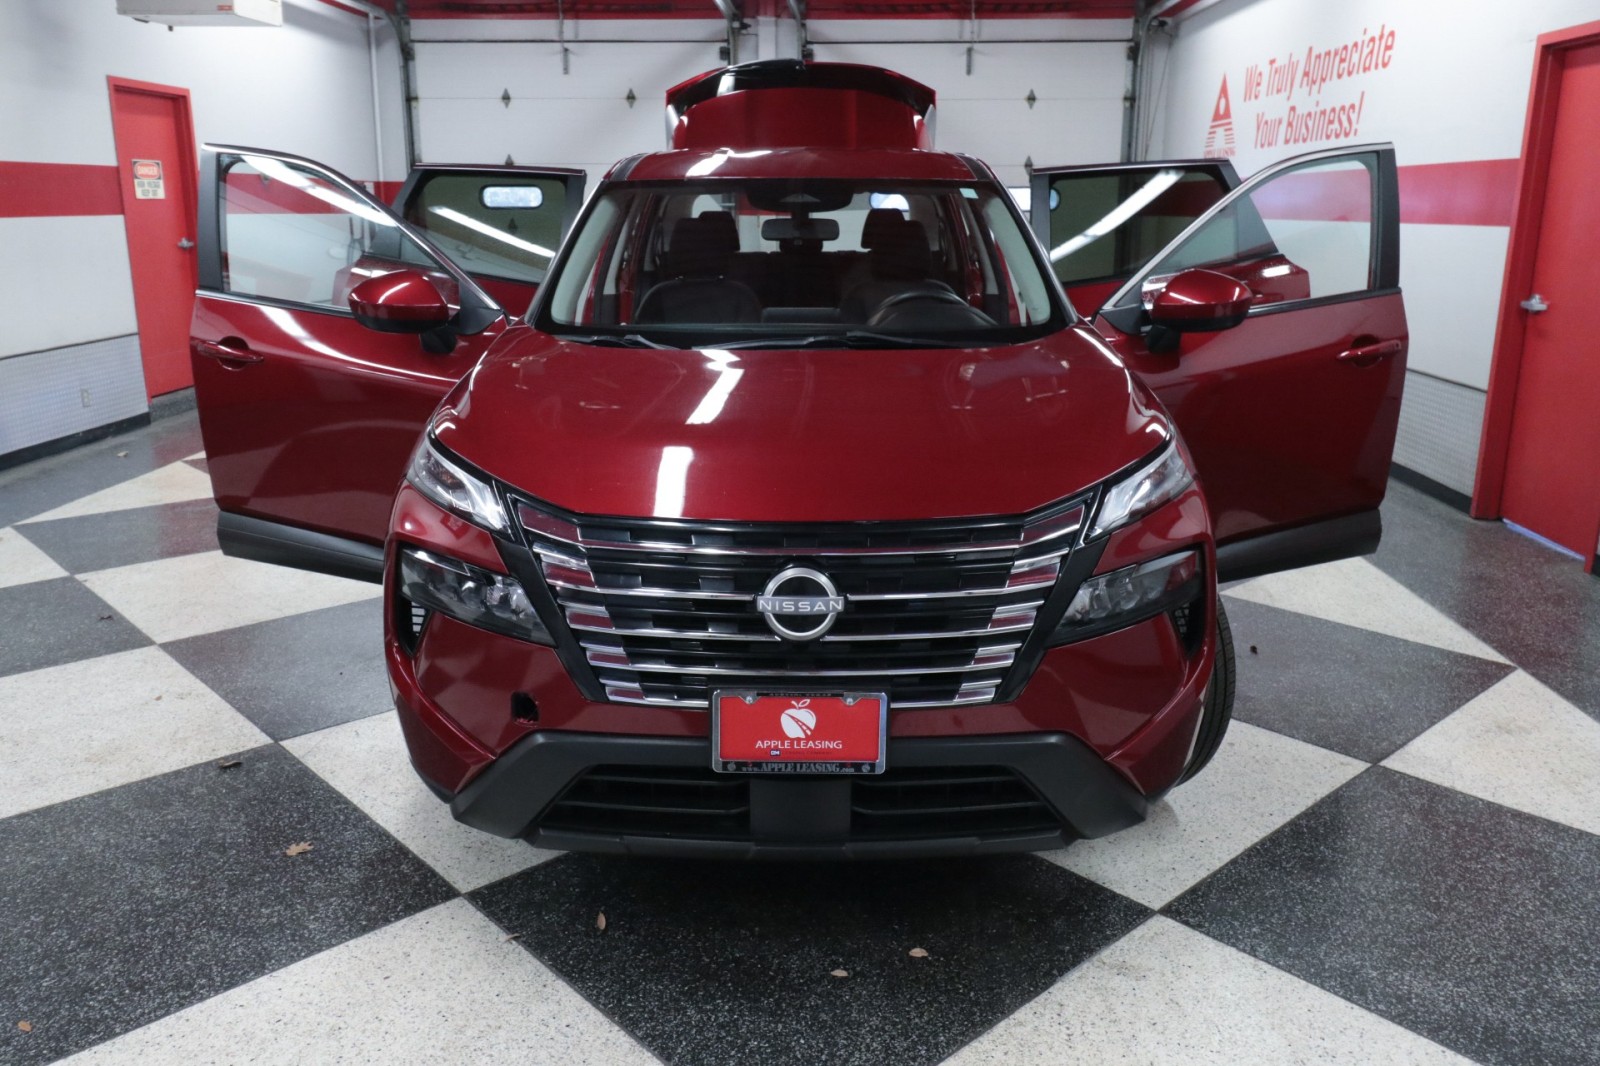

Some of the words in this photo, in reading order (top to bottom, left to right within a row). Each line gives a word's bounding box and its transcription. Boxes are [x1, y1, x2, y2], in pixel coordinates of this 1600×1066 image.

[1244, 64, 1263, 102] We
[1266, 52, 1300, 101] Truly
[1300, 24, 1396, 96] Appreciate
[1254, 112, 1283, 149] Your
[1284, 91, 1365, 145] Business!
[759, 600, 842, 612] NISSAN
[755, 740, 791, 749] APPLE
[794, 740, 843, 749] LEASING
